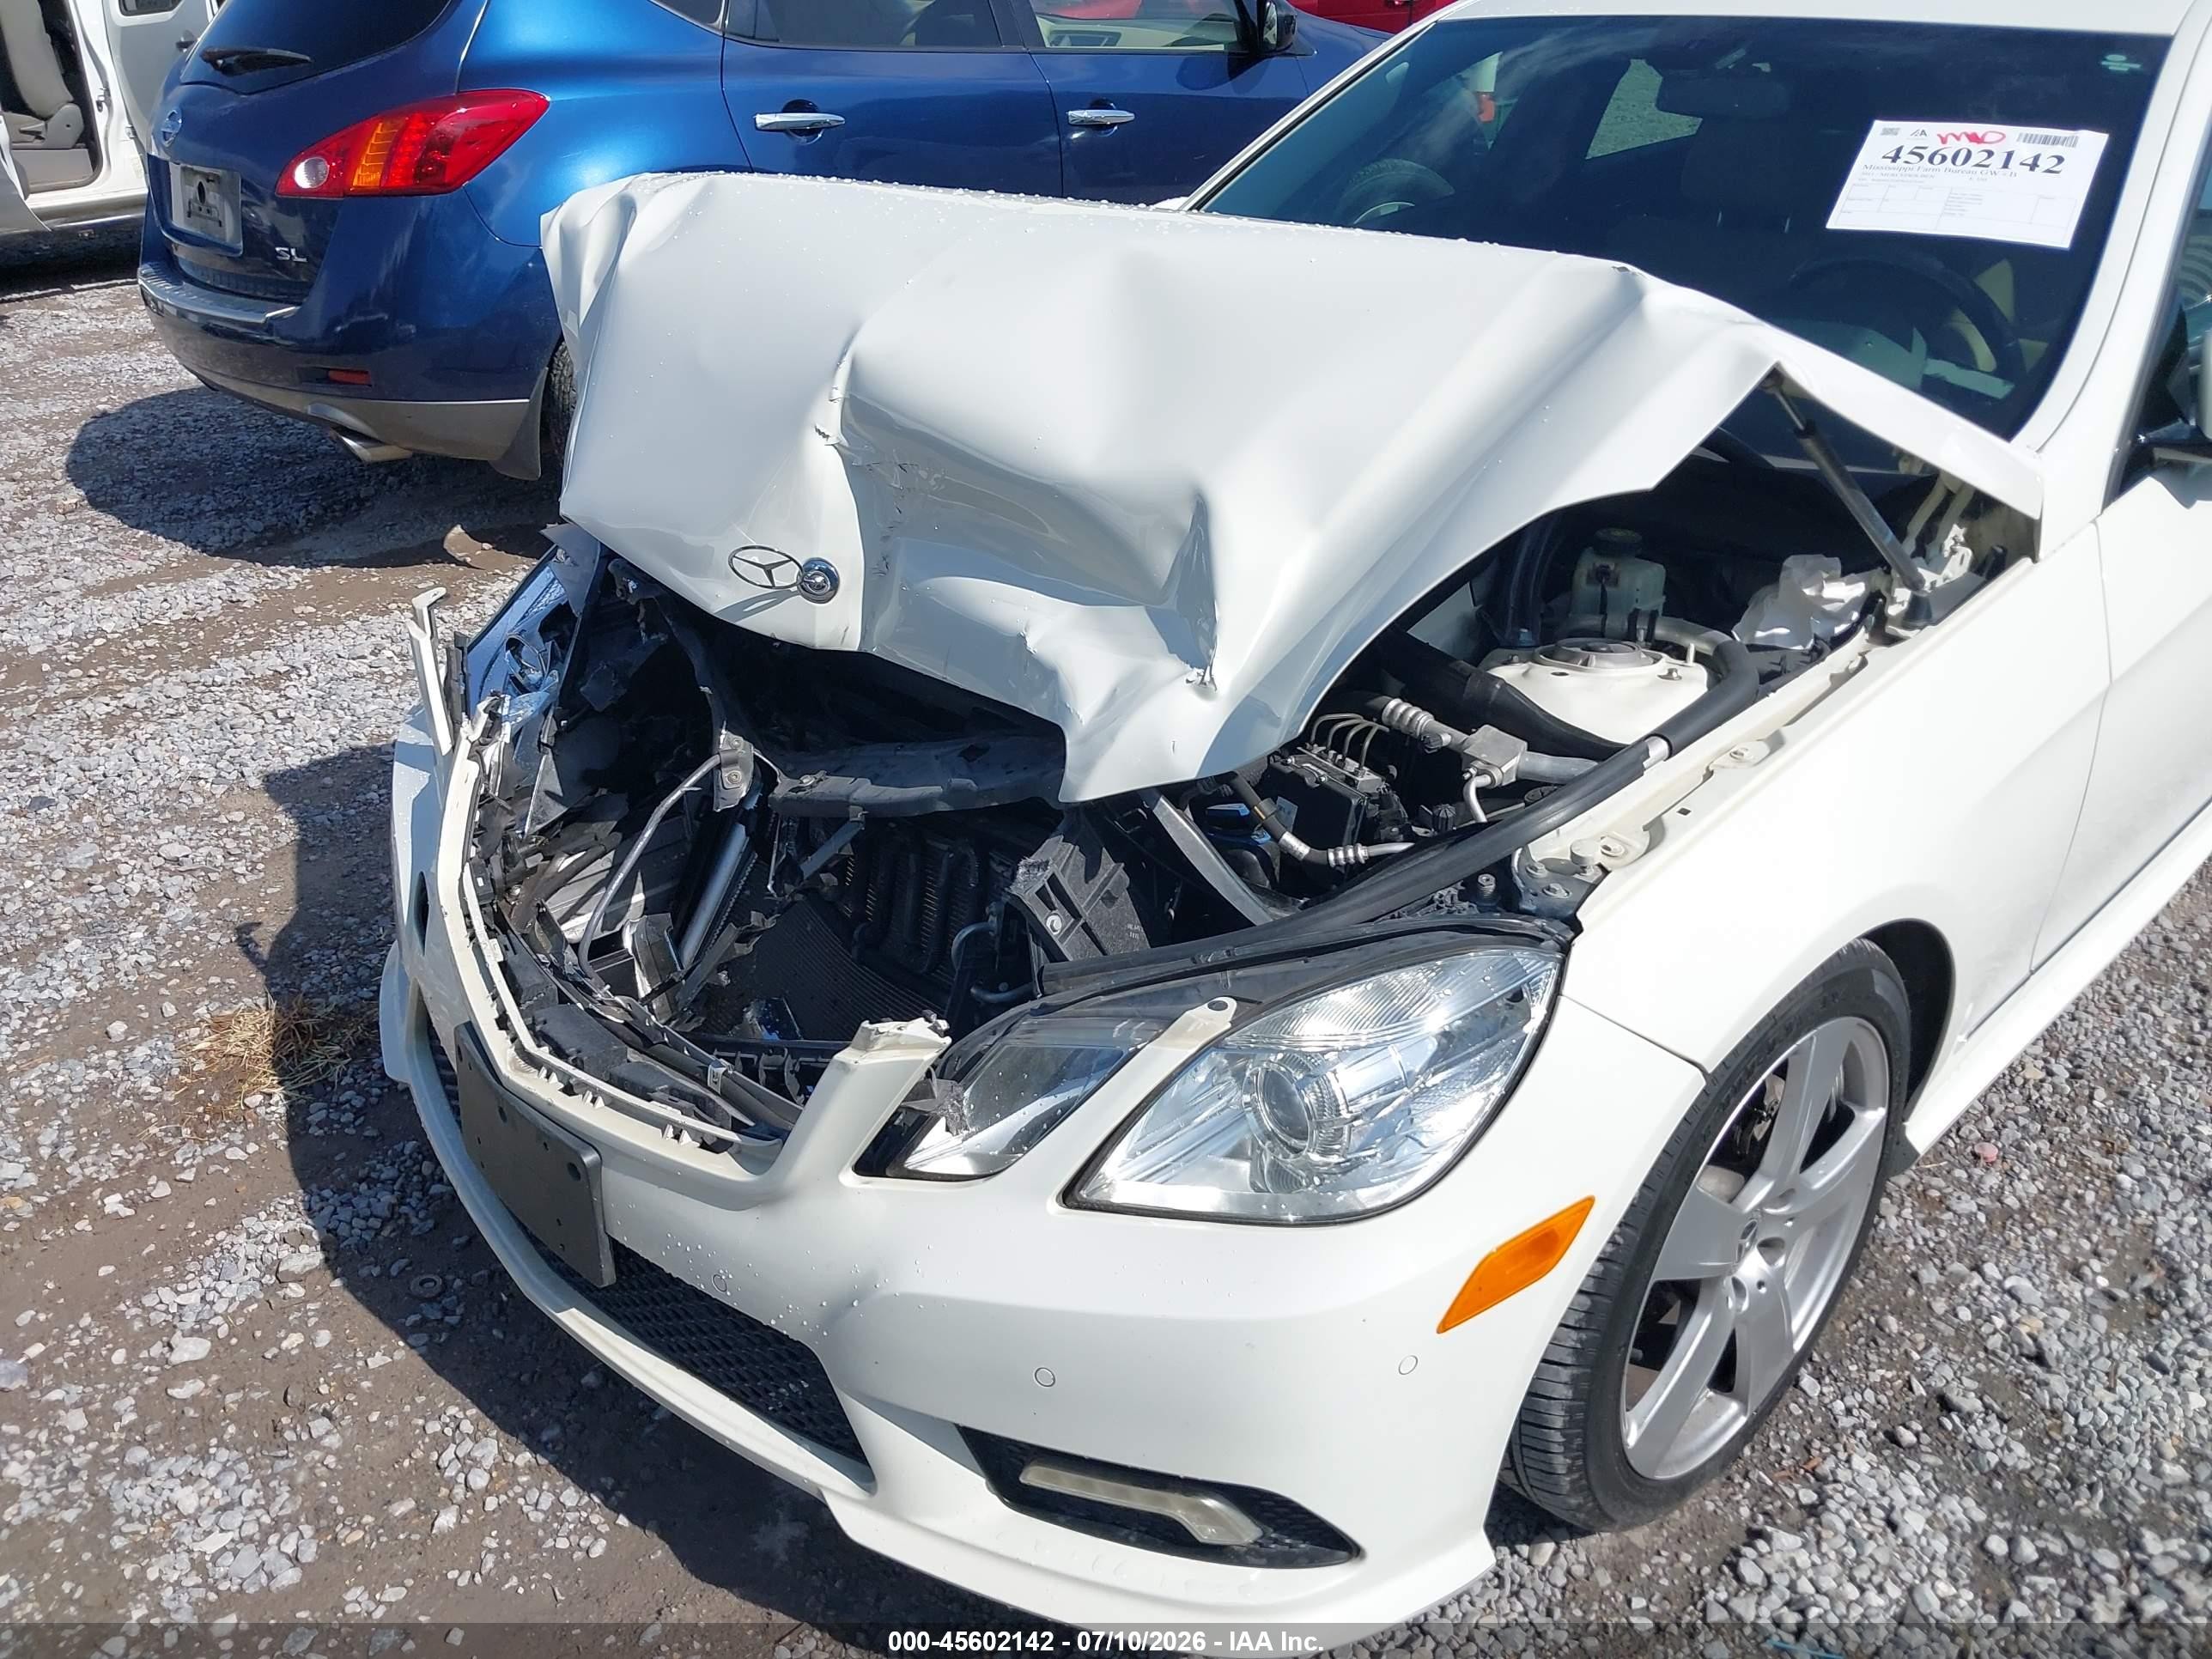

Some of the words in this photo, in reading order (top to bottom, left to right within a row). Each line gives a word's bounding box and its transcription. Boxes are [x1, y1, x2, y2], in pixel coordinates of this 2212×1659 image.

[1881, 143, 2066, 175] 45602142
[1862, 164, 1914, 173] Mississippi
[275, 246, 307, 262] SL
